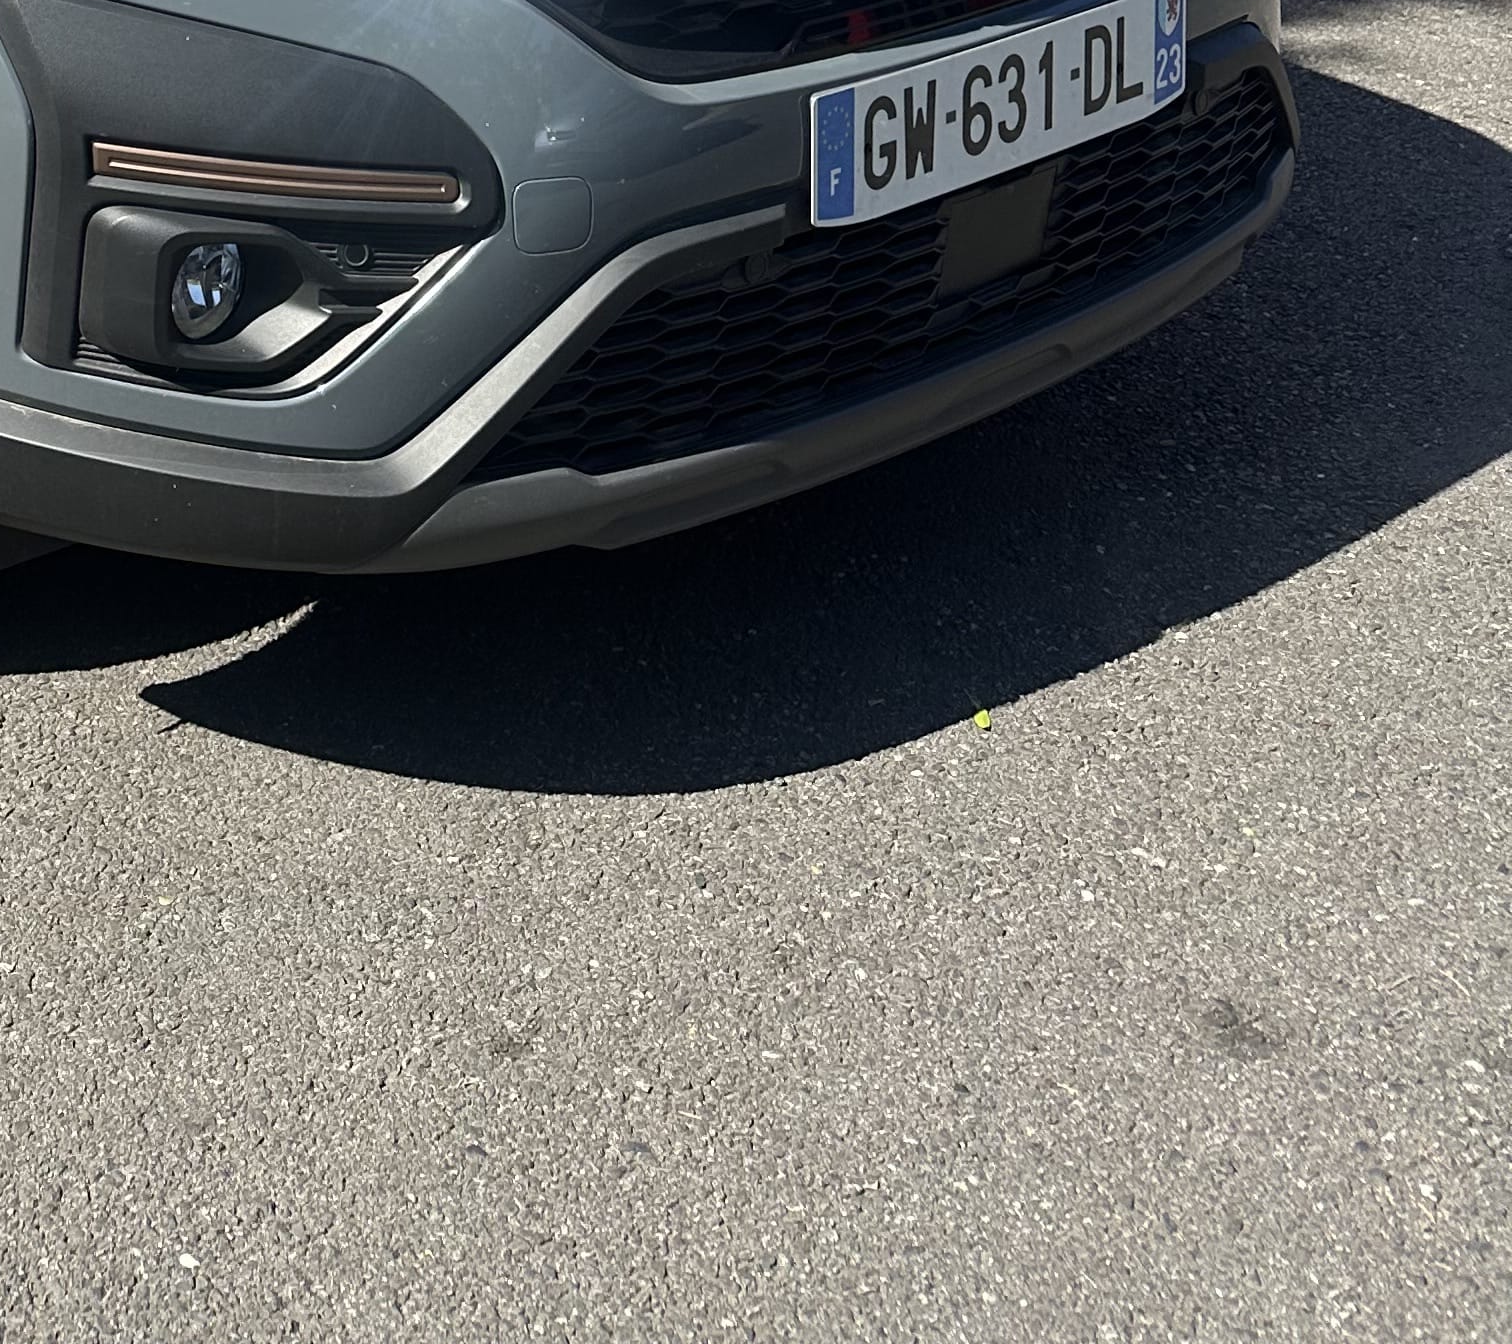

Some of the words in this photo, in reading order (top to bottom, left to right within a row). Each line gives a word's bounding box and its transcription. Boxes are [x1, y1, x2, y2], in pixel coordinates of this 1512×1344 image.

[1156, 43, 1181, 89] 23
[864, 17, 1144, 190] GW-631-DL
[830, 167, 842, 197] F
